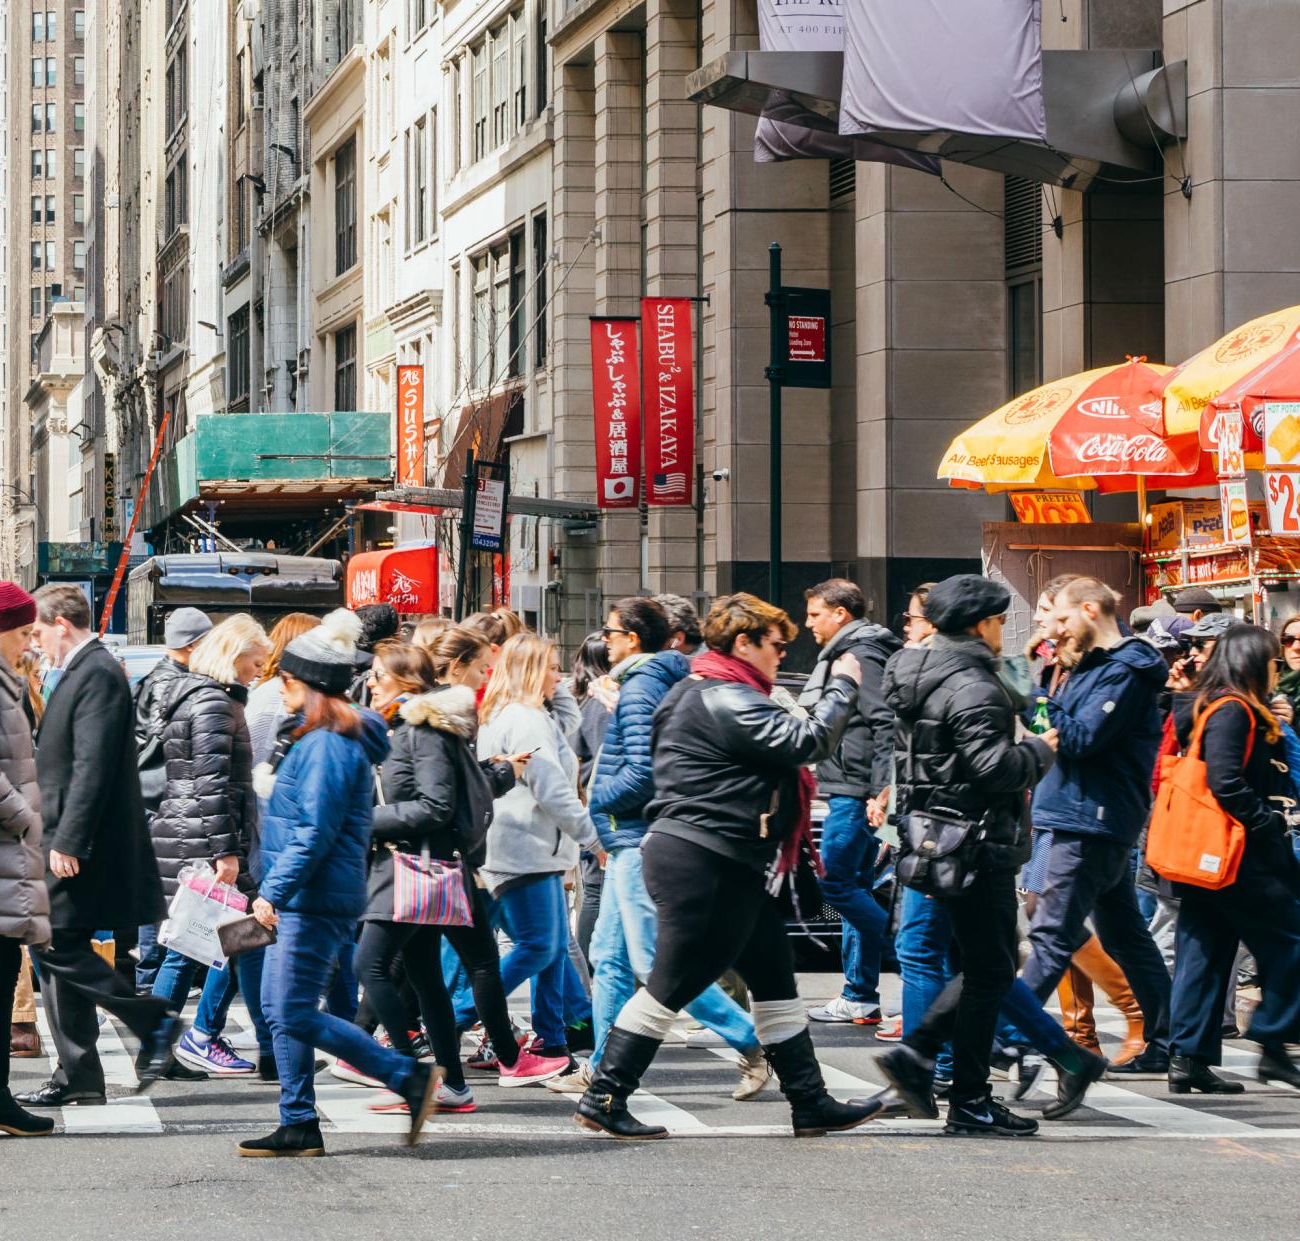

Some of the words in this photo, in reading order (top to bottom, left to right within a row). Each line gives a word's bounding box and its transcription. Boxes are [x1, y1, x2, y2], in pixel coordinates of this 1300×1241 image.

[799, 25, 819, 33] 400
[796, 320, 818, 330] STANDING
[658, 372, 671, 383] &
[1176, 400, 1191, 413] All
[659, 386, 677, 468] IZAKAYA
[403, 389, 419, 478] SUSHI
[947, 454, 965, 464] All
[967, 455, 991, 467] Beef
[478, 481, 484, 491] 3
